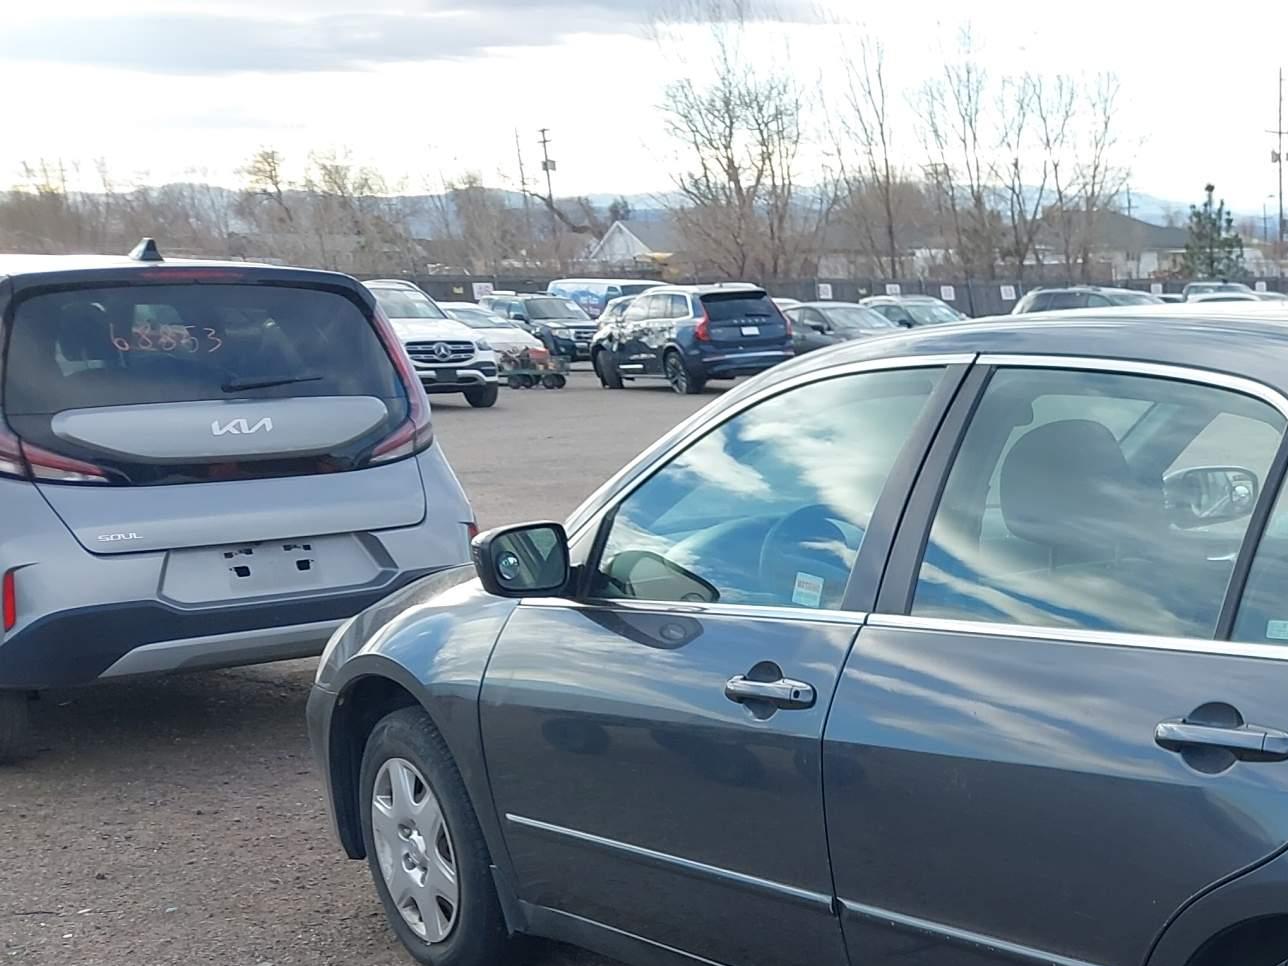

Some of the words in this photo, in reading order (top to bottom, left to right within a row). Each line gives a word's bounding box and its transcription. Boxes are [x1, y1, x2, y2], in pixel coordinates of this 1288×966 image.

[109, 322, 222, 353] 68853
[211, 417, 273, 436] KIA
[98, 532, 144, 542] SOUL
